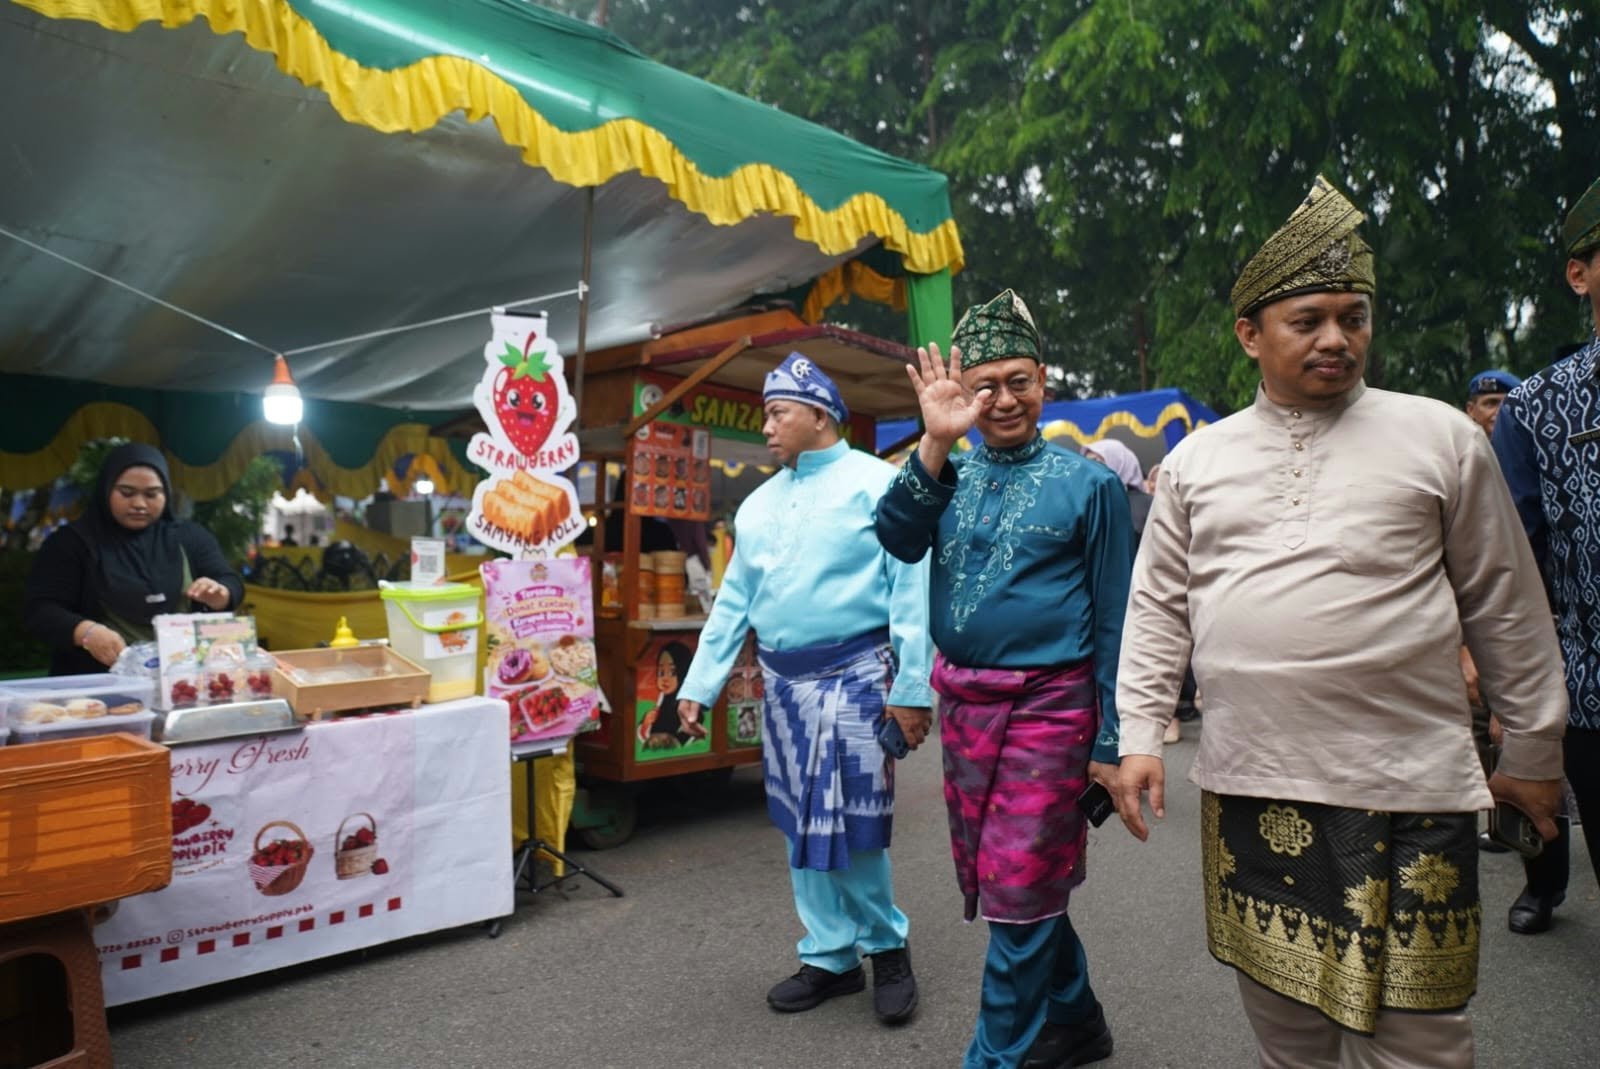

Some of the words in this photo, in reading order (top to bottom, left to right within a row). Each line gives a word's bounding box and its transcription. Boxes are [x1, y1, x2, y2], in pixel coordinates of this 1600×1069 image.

[691, 395, 762, 431] SANZA
[476, 440, 574, 471] STRAWBERRY
[475, 514, 541, 548] SAMYANG
[547, 518, 579, 546] ROLL
[227, 735, 309, 775] Fresh
